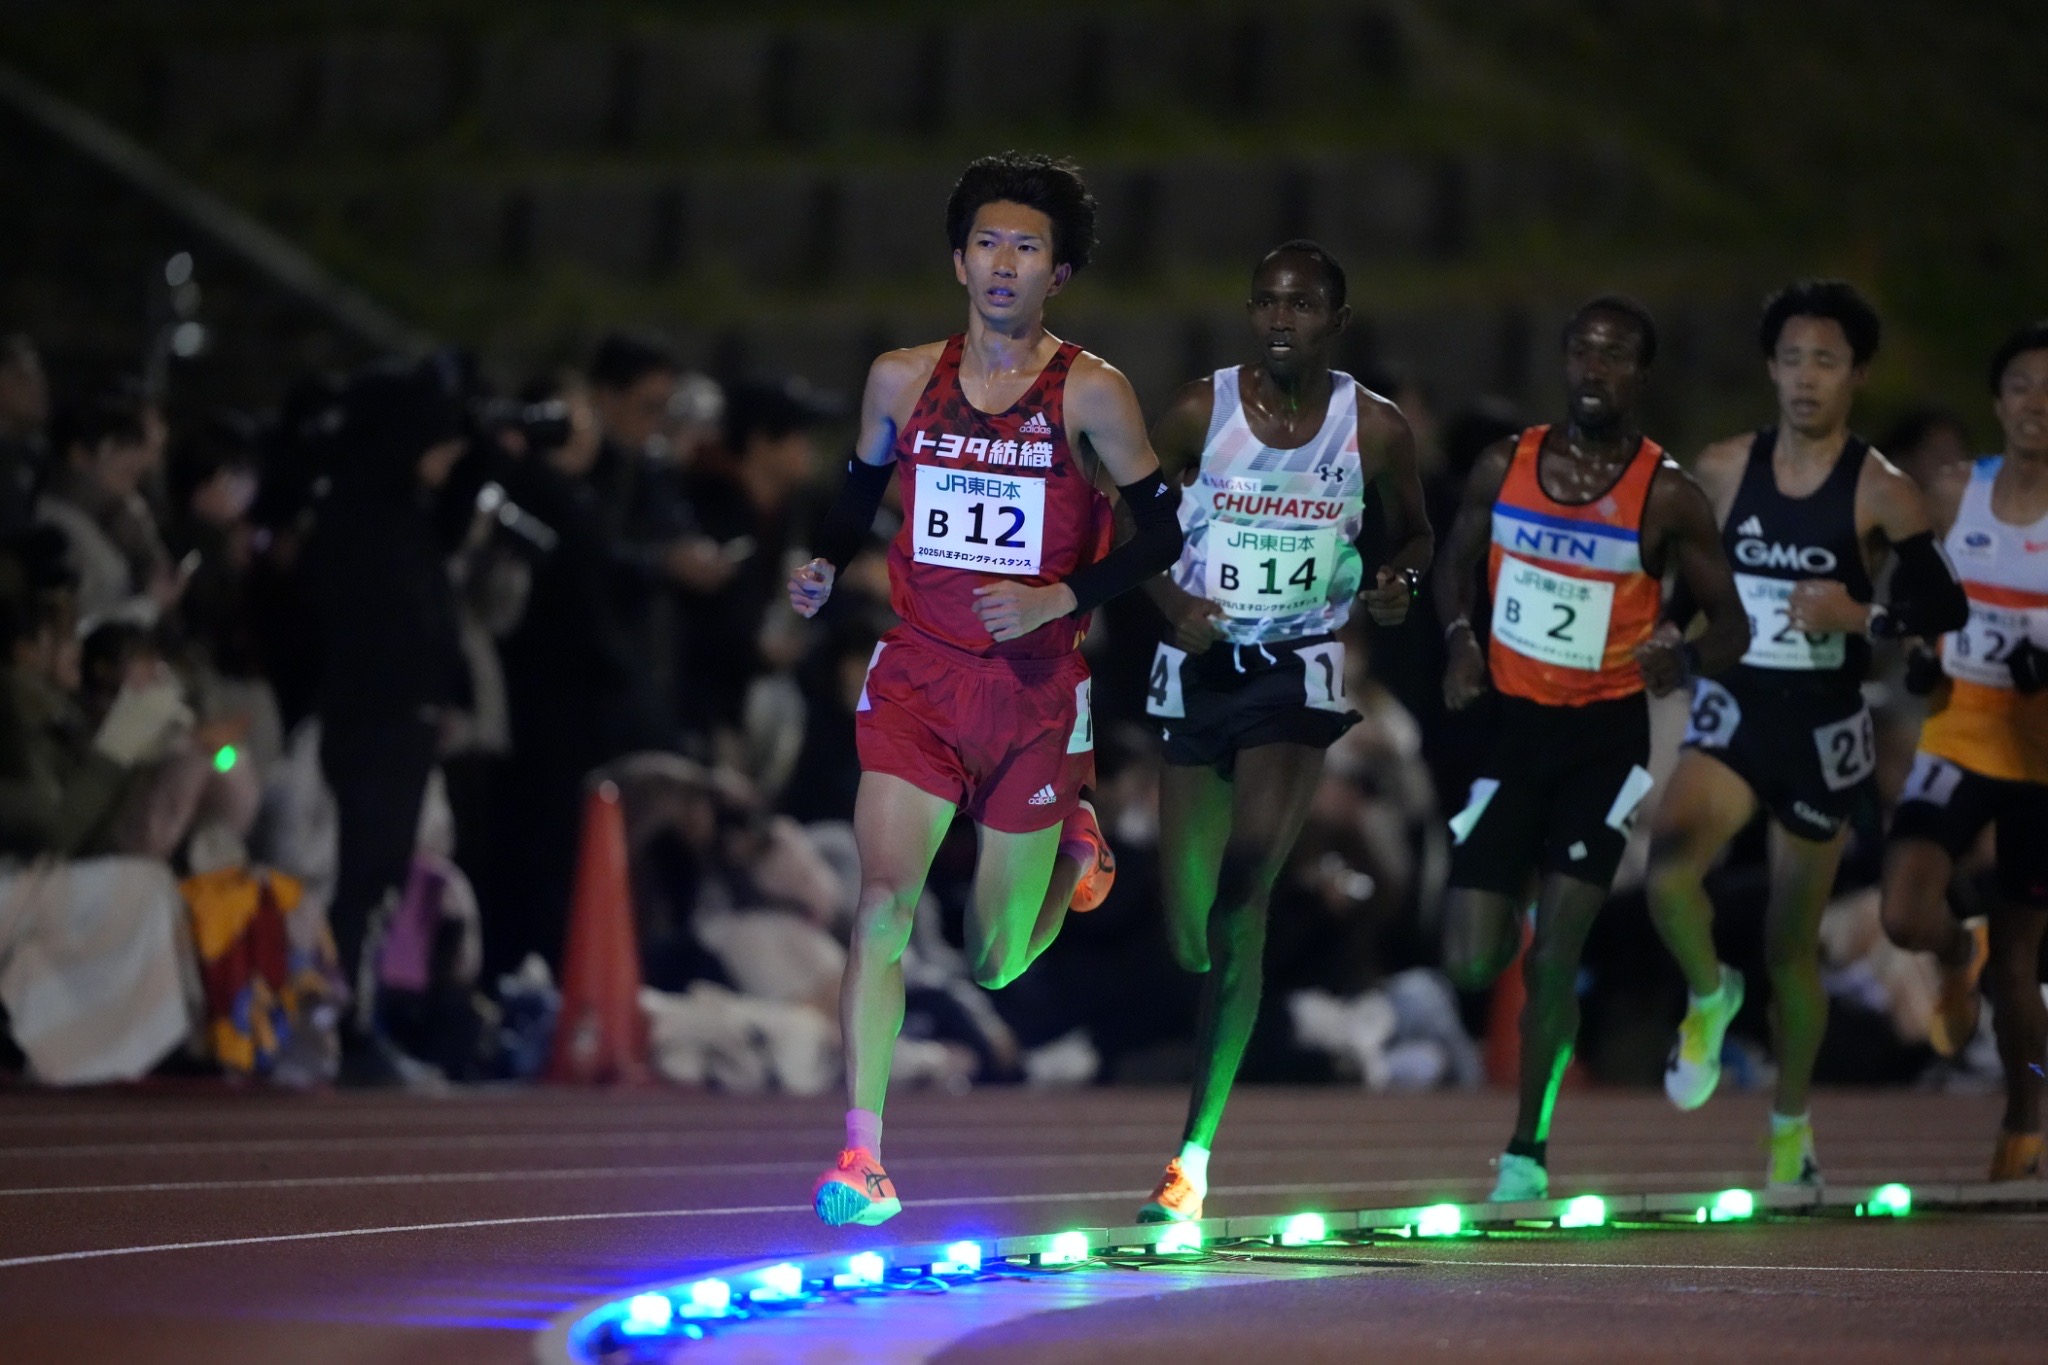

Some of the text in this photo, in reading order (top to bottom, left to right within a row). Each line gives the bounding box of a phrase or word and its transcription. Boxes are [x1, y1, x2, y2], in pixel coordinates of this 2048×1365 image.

[1019, 425, 1052, 435] adidas
[912, 430, 1054, 468] トヨタ紡織
[936, 474, 1021, 500] JR東日本
[1213, 492, 1344, 520] CHUHATSU
[927, 502, 1026, 549] B 12
[1227, 531, 1315, 552] JR東日本
[1514, 526, 1597, 561] NTN
[1734, 538, 1838, 574] GMO
[1220, 556, 1317, 595] B 14
[1505, 596, 1577, 642] B 2
[1150, 653, 1169, 707] 4
[1692, 691, 1729, 734] 6
